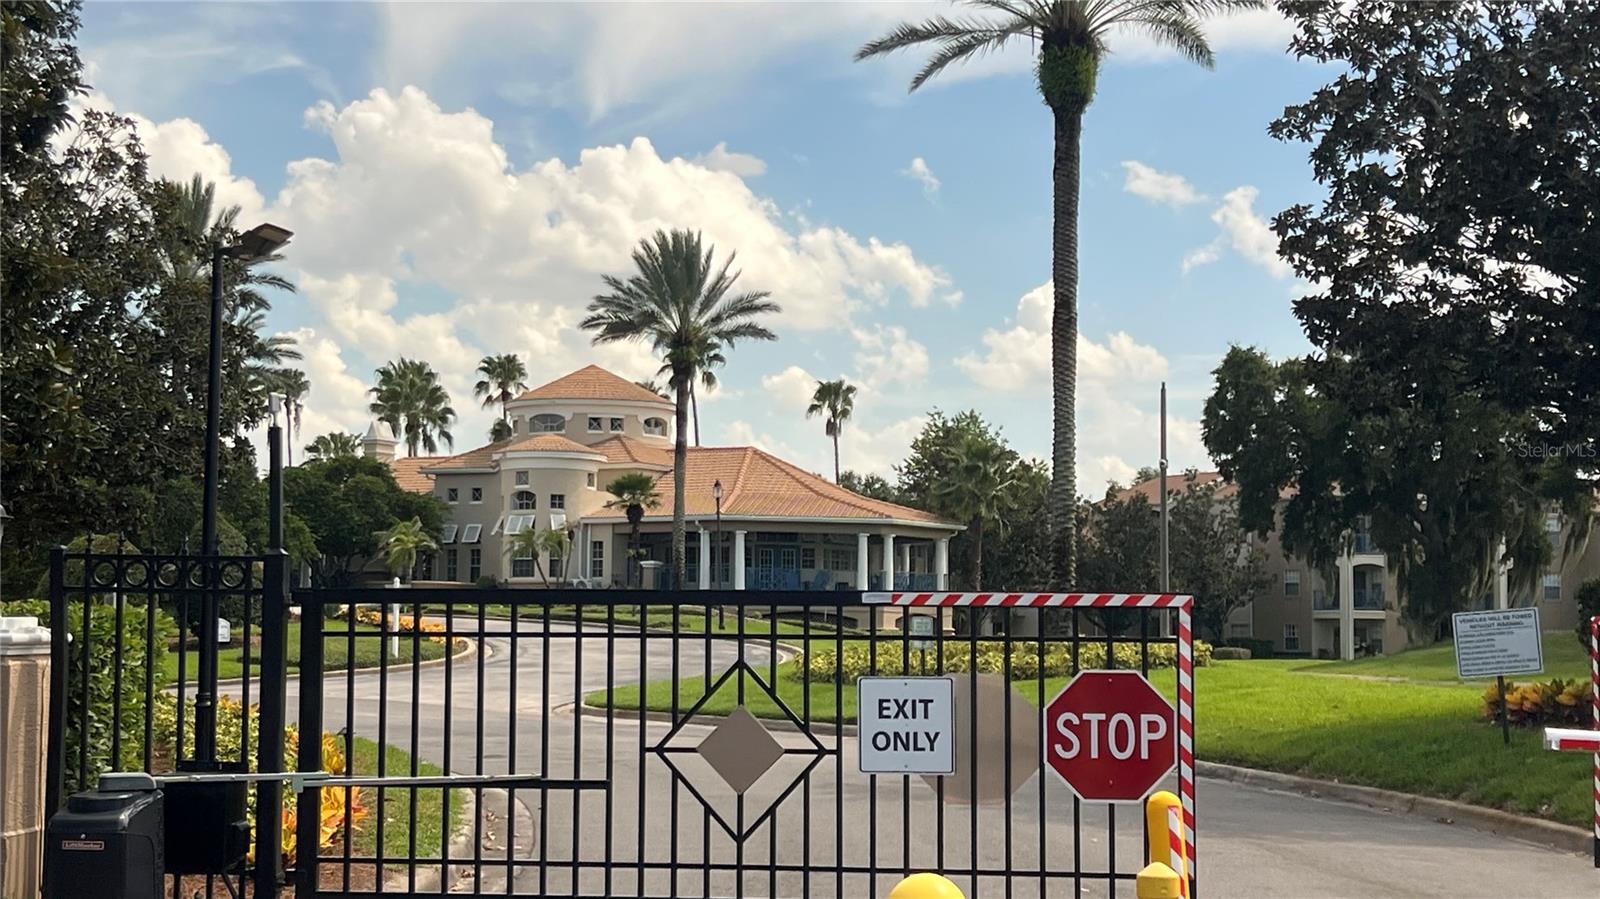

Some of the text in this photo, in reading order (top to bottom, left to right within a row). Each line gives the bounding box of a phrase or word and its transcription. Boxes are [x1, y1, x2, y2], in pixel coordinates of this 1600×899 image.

[878, 699, 934, 719] EXIT
[872, 731, 940, 751] ONLY
[1054, 712, 1167, 760] STOP
